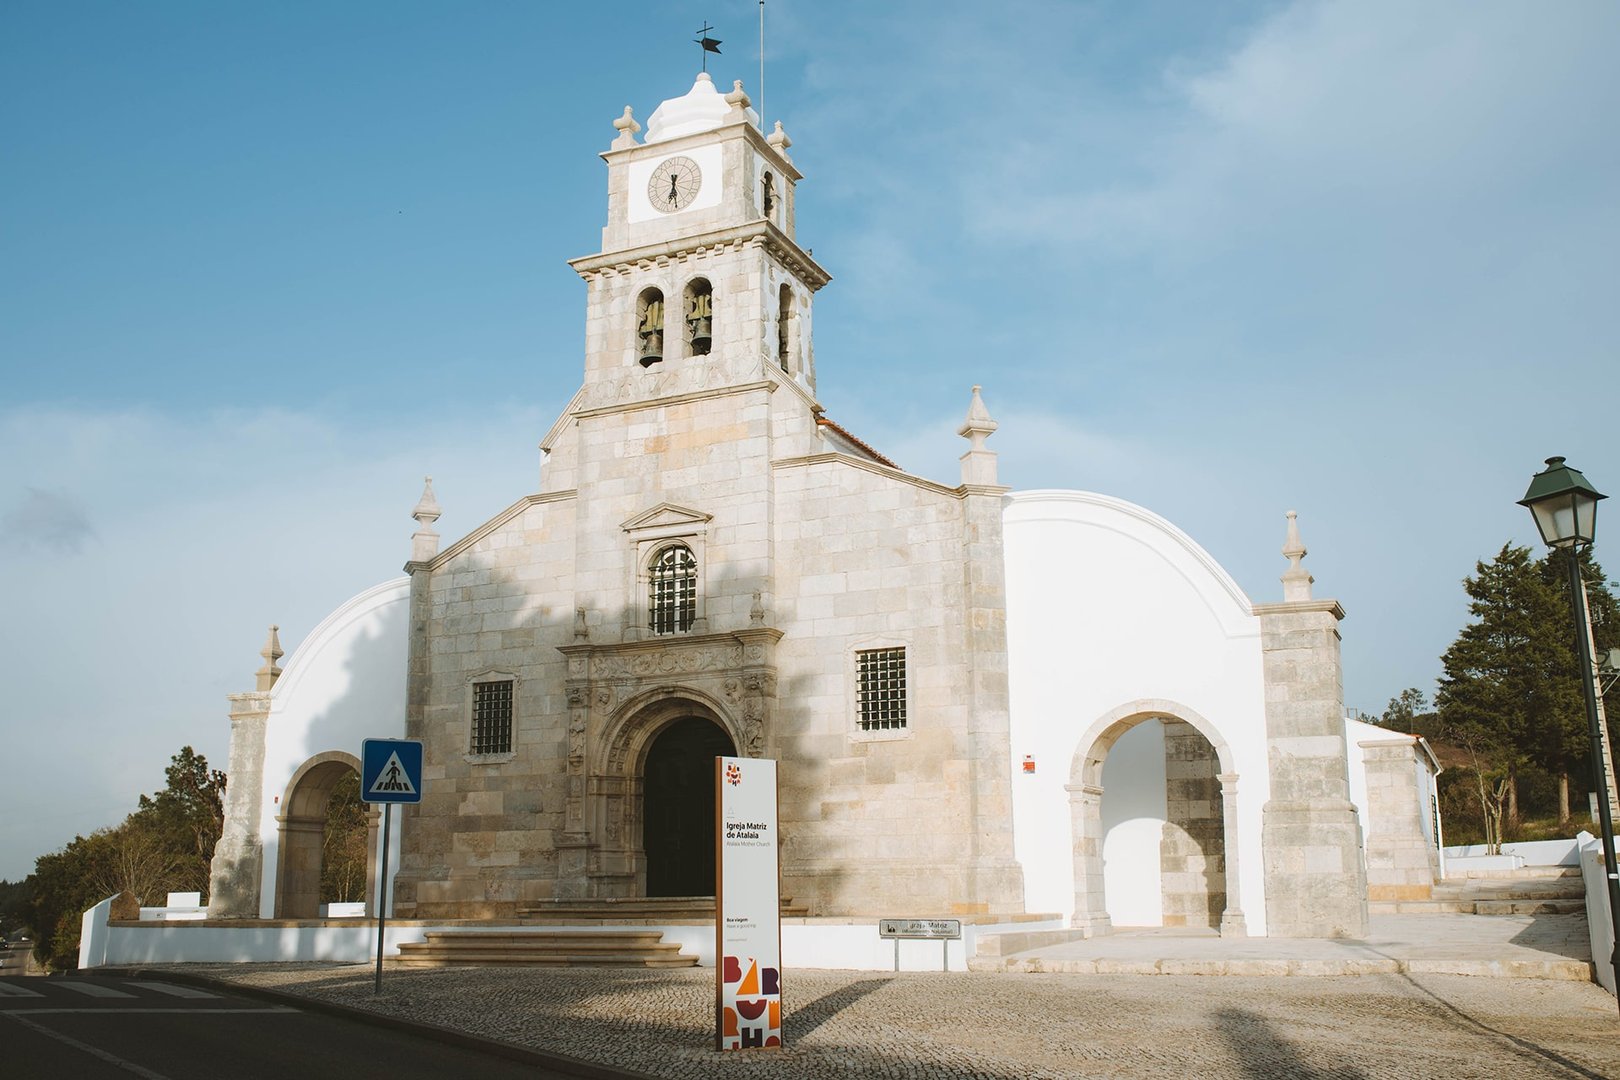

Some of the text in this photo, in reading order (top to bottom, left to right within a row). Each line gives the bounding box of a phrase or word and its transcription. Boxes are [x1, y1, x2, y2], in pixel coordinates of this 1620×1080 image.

[726, 821, 767, 831] Igreja Matriz
[736, 831, 759, 839] Atalaia
